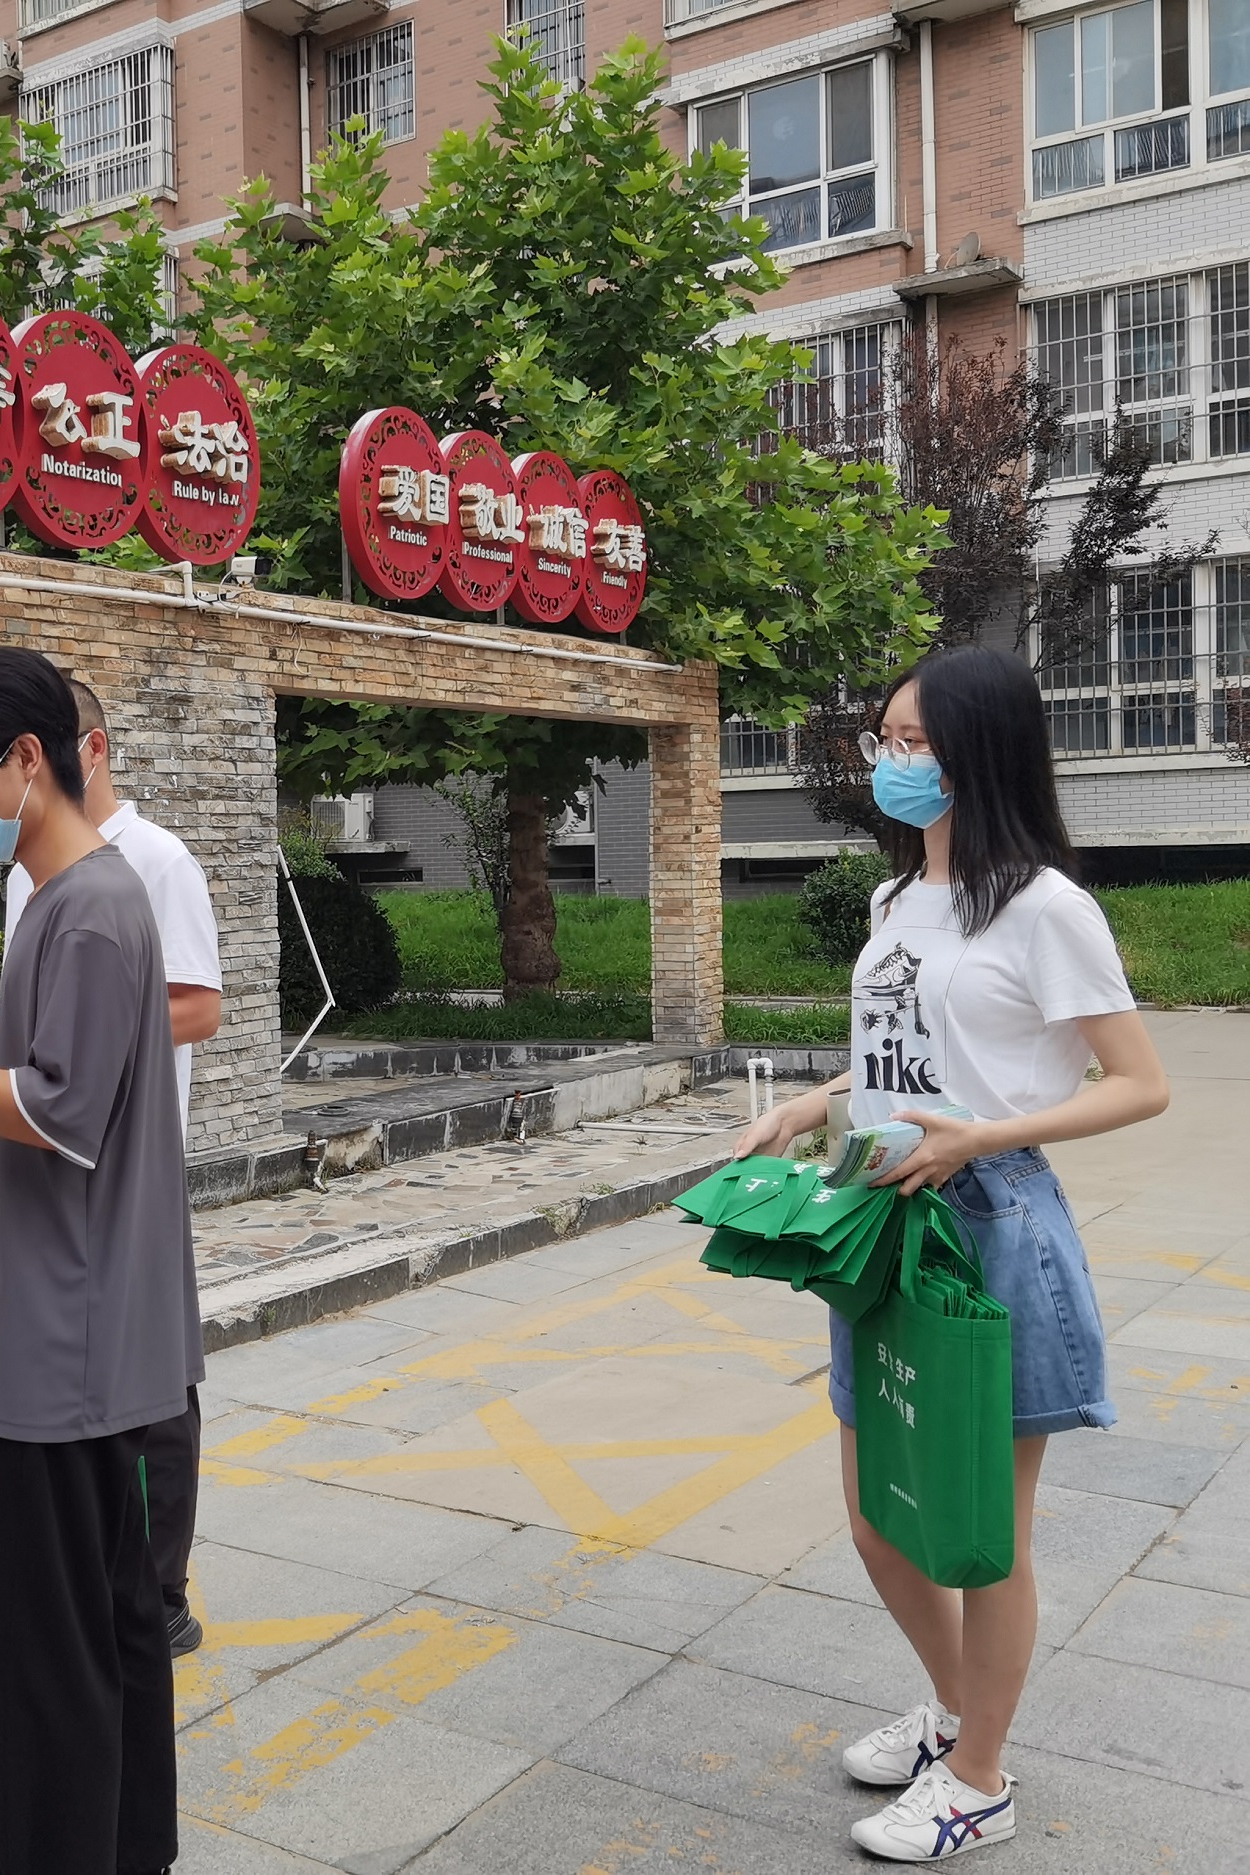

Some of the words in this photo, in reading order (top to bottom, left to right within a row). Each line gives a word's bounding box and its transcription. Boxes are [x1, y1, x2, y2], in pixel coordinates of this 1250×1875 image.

[32, 382, 140, 460] 公正
[158, 411, 249, 484] 法治
[172, 480, 200, 500] Rule
[201, 486, 215, 507] by
[377, 464, 449, 526] 爱国
[458, 482, 525, 544] 敬业
[388, 525, 428, 546] Patriotic
[462, 541, 513, 563] Professional
[526, 503, 589, 560] 诚信
[591, 518, 646, 572] 友善
[537, 557, 572, 578] Sincerity
[601, 571, 628, 590] Friendly
